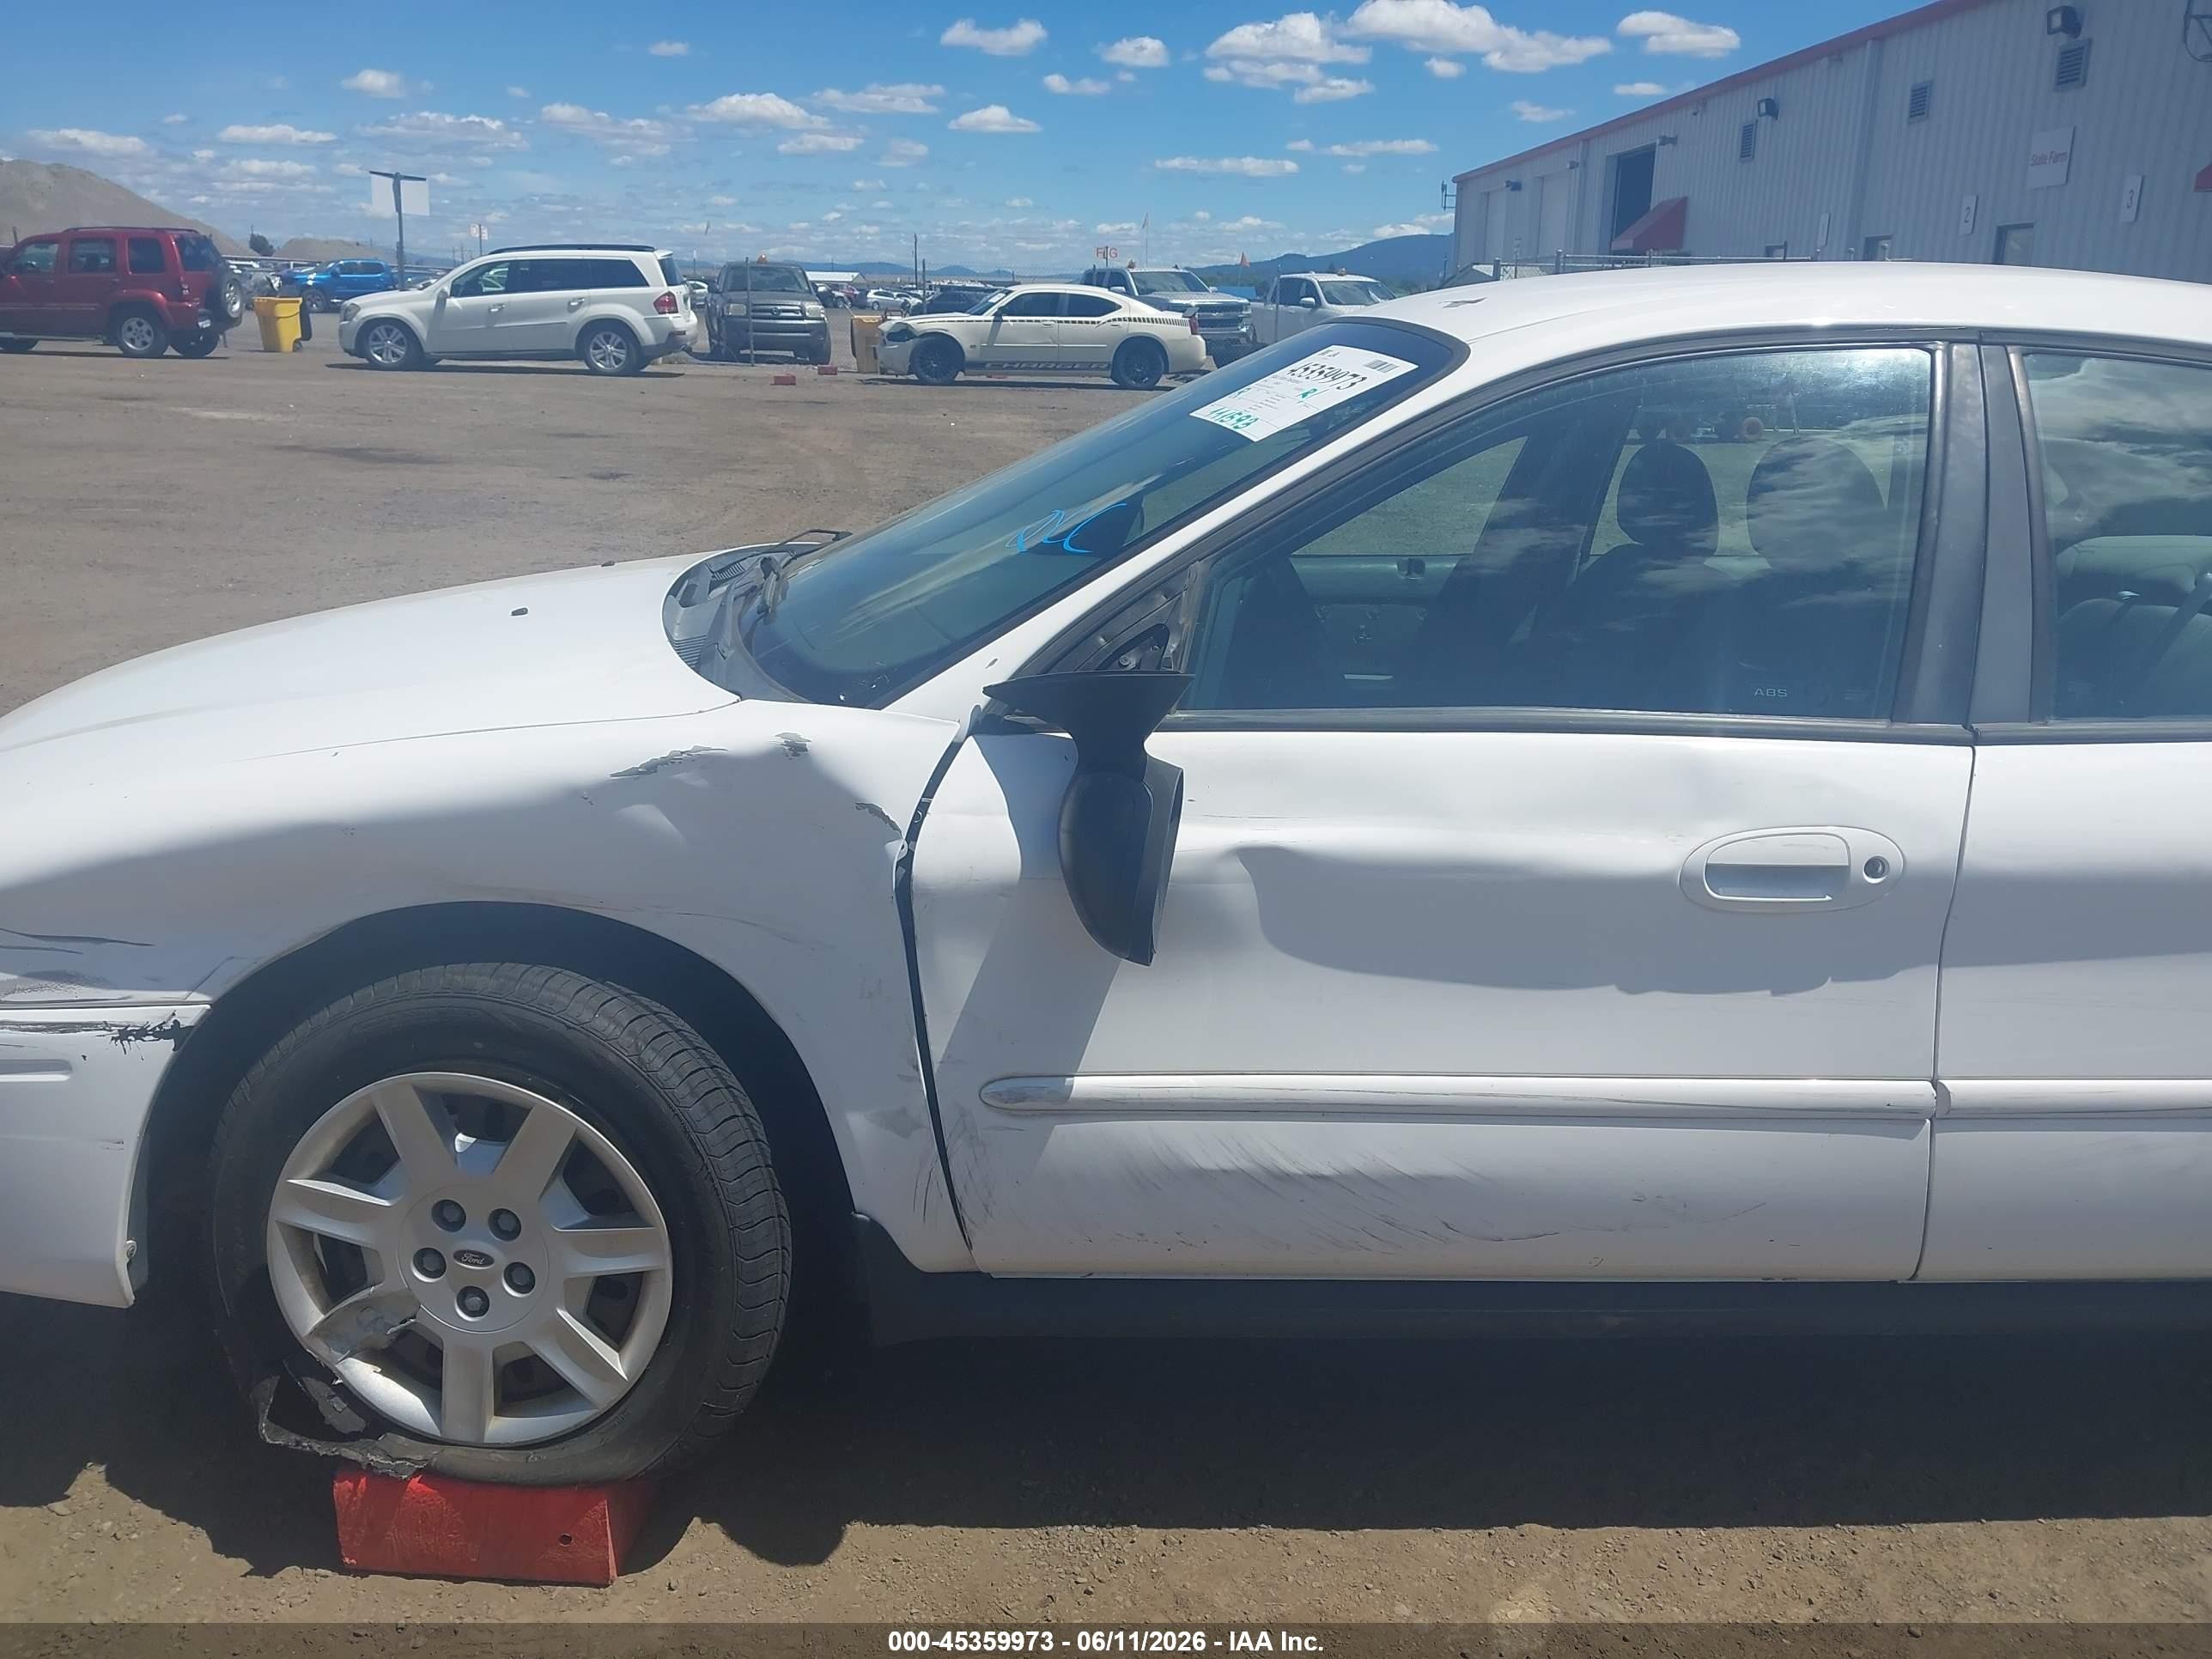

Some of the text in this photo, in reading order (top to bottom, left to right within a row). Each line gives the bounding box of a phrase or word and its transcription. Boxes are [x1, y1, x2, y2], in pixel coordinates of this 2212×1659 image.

[2048, 151, 2068, 164] Farm
[2126, 189, 2134, 208] 3
[1964, 206, 1972, 223] 2
[1286, 362, 1367, 390] 45359973
[1753, 688, 1787, 697] ABS
[461, 1252, 485, 1264] Ford
